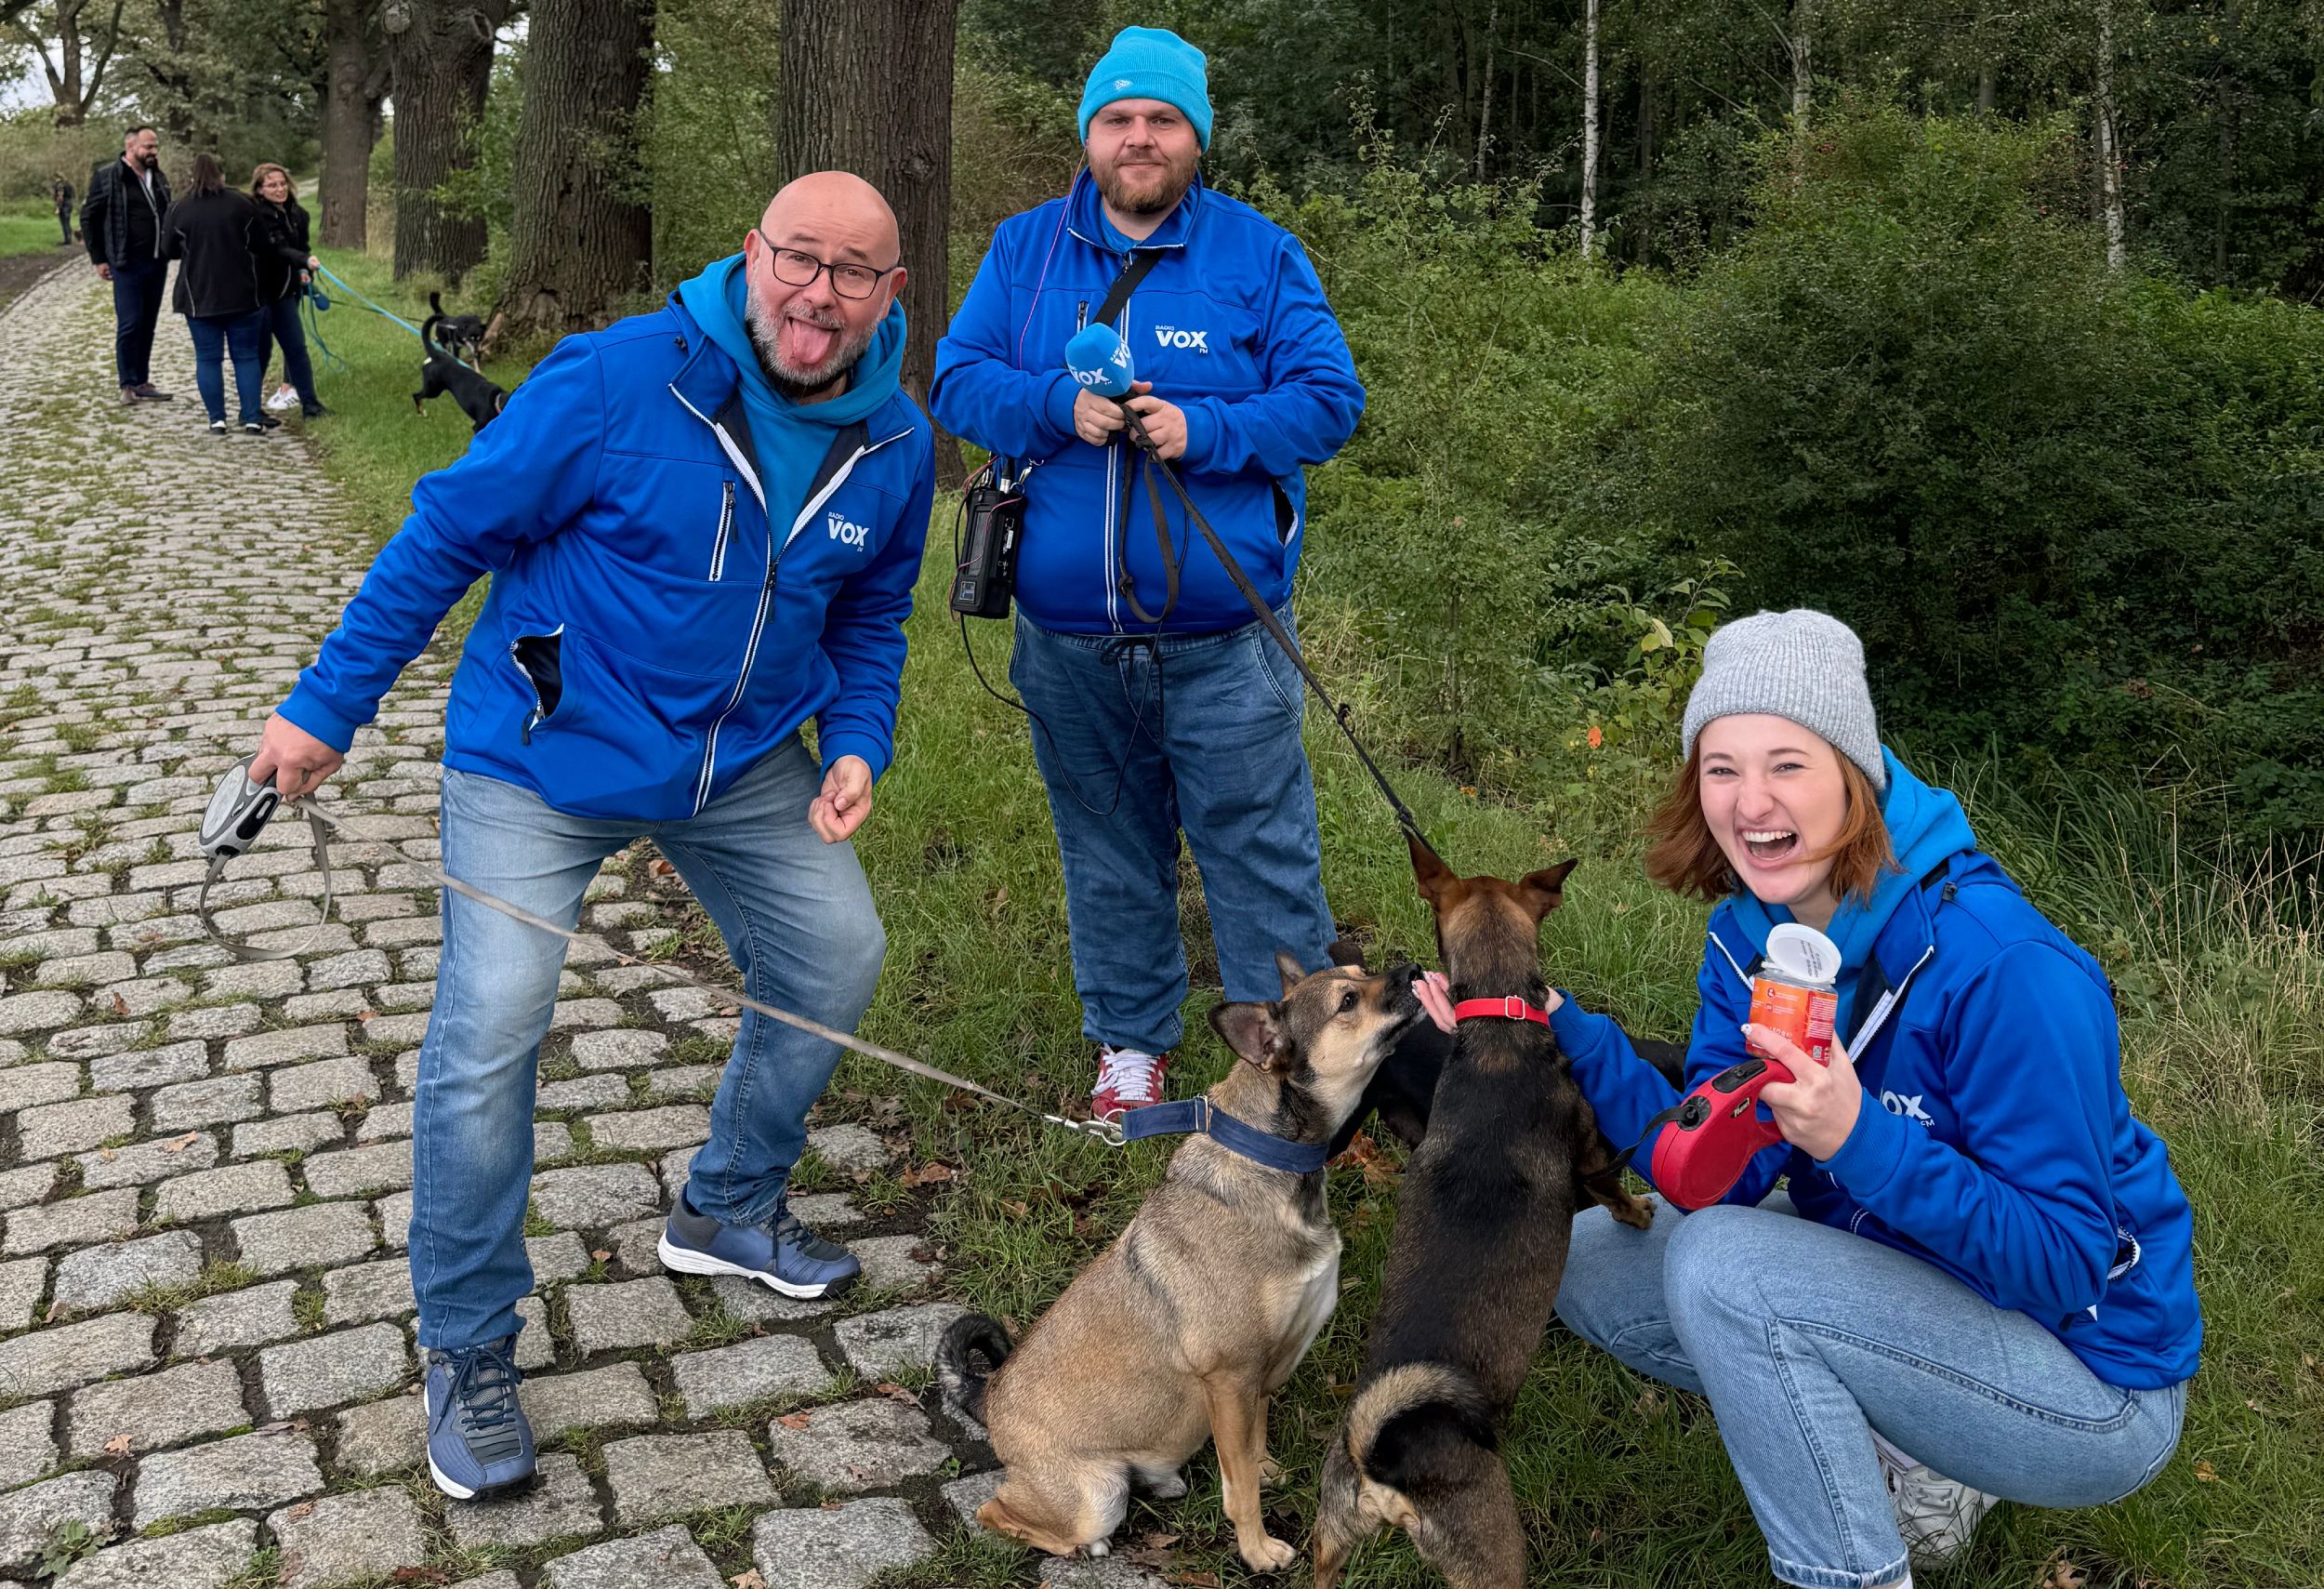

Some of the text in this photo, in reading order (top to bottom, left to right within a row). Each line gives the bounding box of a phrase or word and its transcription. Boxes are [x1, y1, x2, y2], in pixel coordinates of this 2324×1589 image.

[1155, 330, 1208, 349] VOX
[828, 511, 844, 520] RADIO
[828, 518, 869, 546] VOX
[1879, 1088, 1932, 1119] OX
